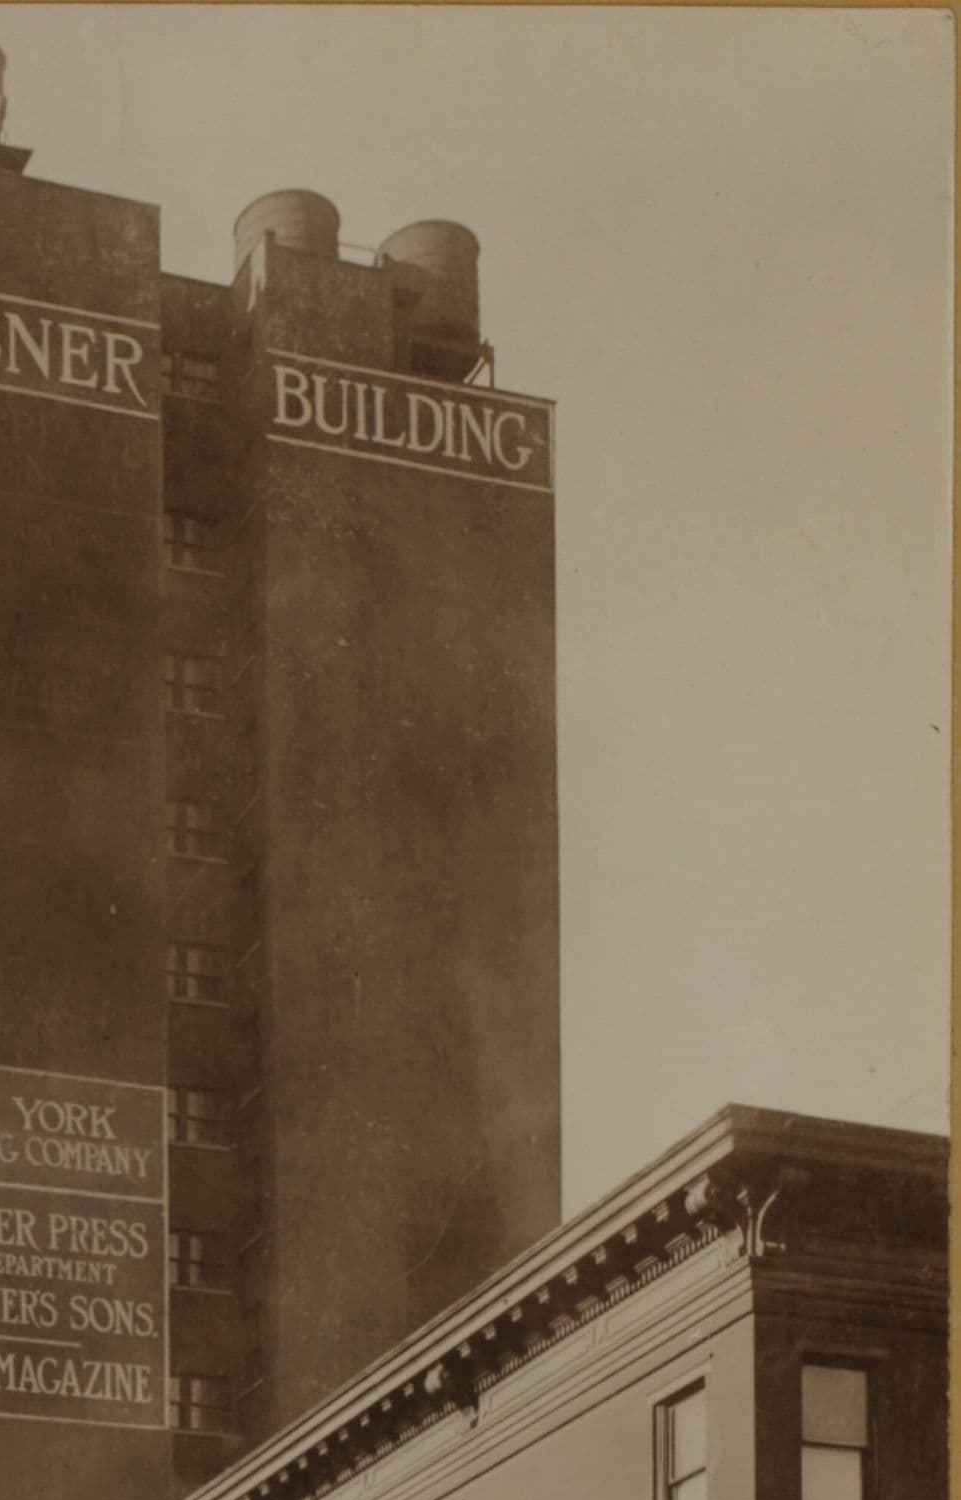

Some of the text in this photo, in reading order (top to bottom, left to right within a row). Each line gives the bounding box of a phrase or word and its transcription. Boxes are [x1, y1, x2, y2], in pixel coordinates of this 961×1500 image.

[273, 366, 533, 470] BUILDING
[11, 1097, 117, 1140] YORK
[25, 1137, 153, 1178] COMPANY
[48, 1214, 149, 1260] PRESS
